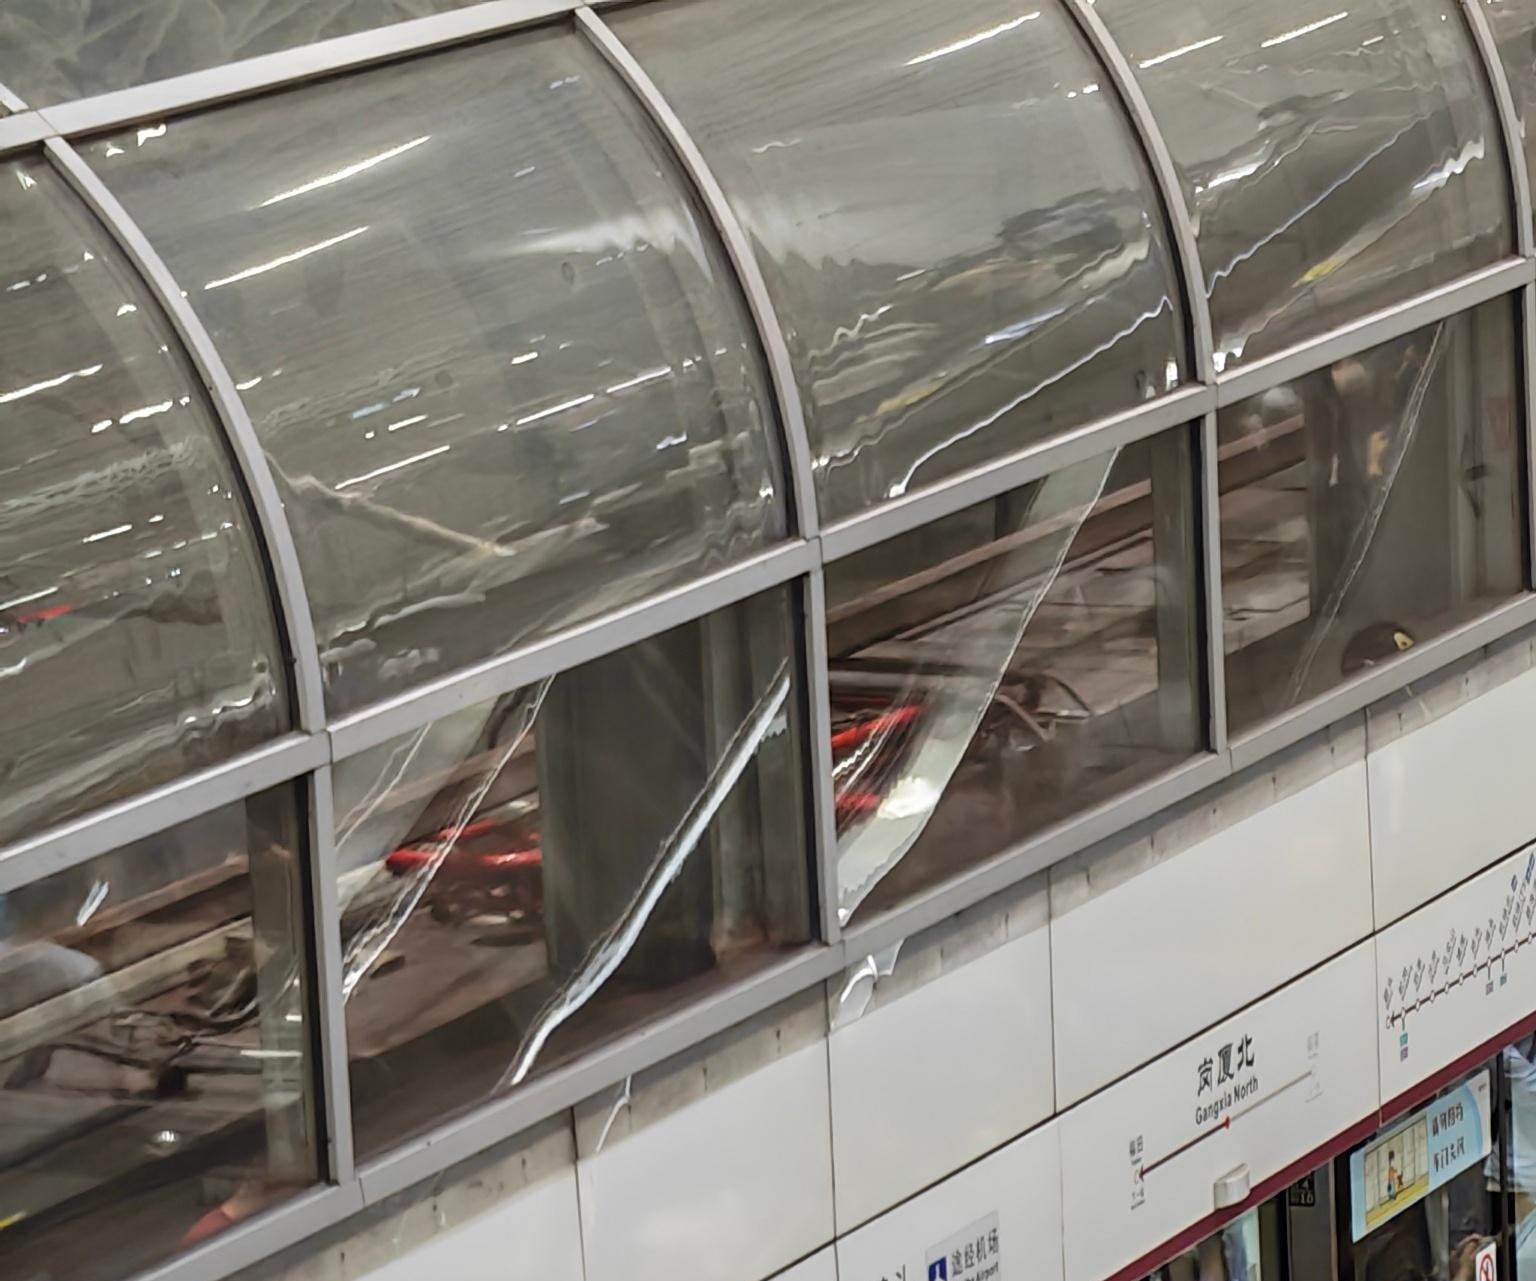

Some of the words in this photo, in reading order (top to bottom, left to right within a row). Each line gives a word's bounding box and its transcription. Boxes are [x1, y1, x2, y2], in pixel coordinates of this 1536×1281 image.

[1197, 1033, 1256, 1097] 岗厦北
[1195, 1091, 1233, 1125] Gangxia
[1233, 1076, 1259, 1105] North
[951, 1228, 1000, 1277] 途经机场
